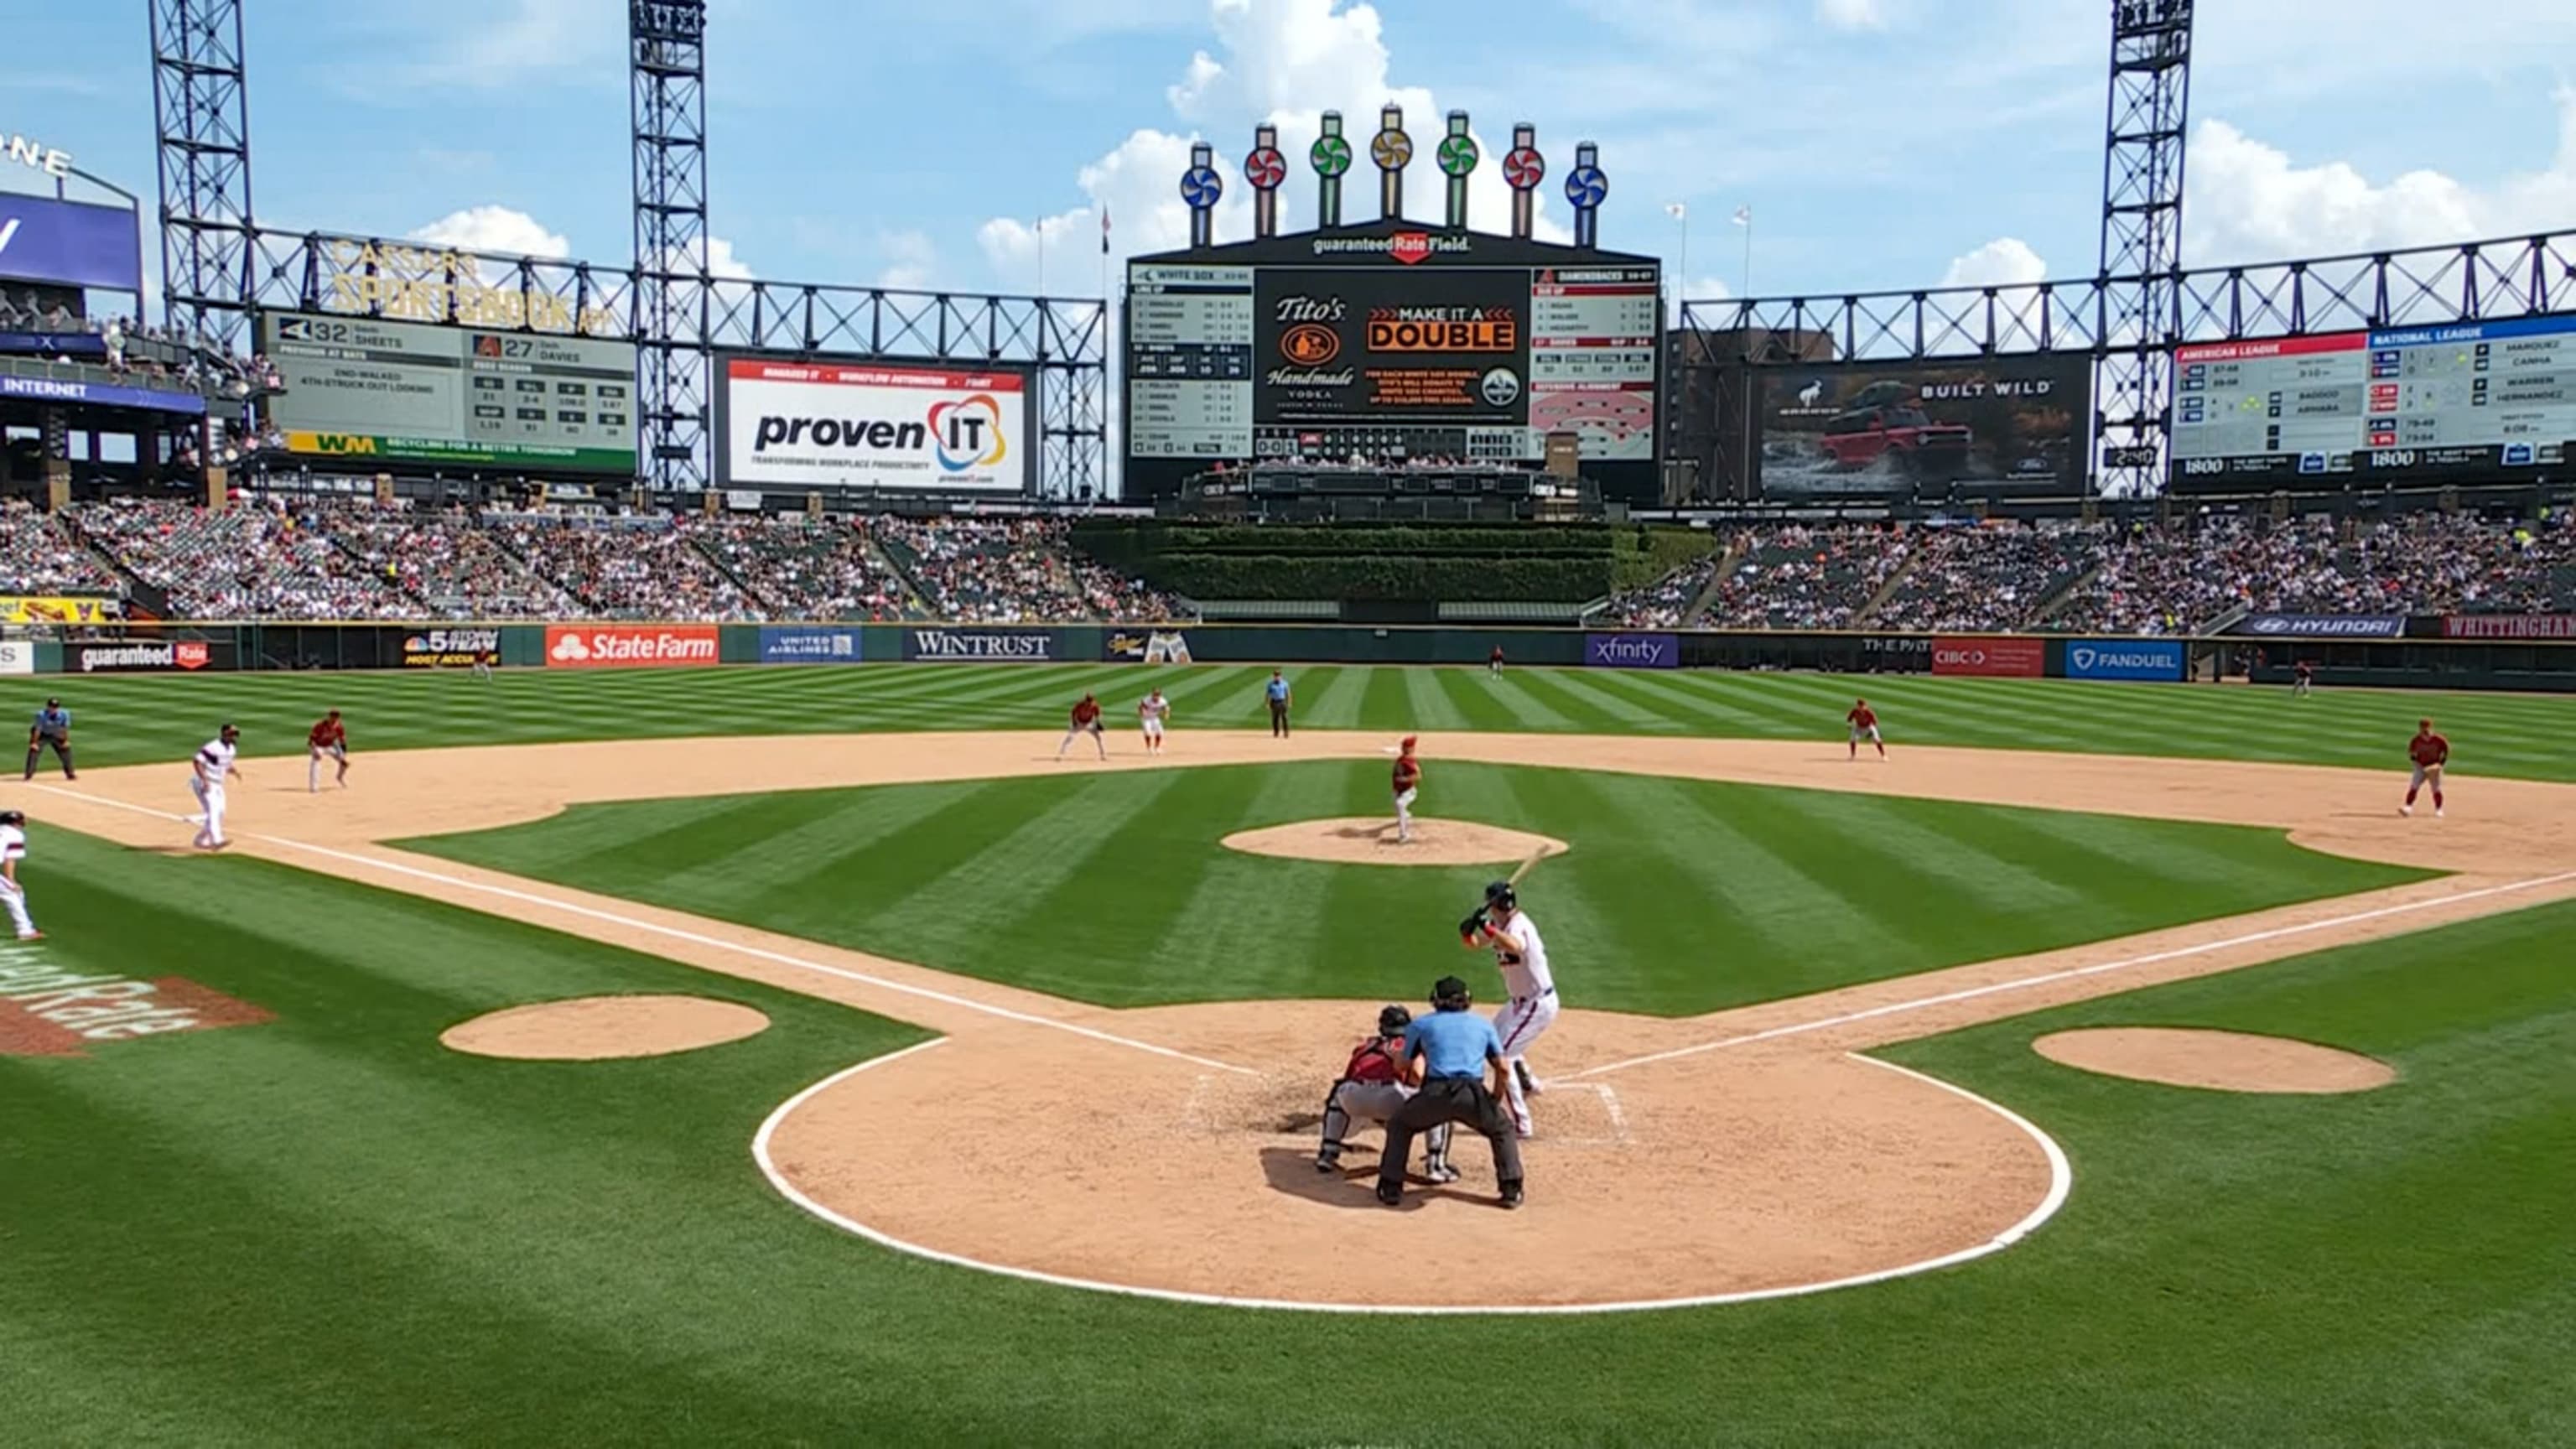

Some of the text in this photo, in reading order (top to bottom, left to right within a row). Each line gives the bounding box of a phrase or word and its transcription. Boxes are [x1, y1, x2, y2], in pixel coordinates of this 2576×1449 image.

[0, 135, 70, 178] NE
[1313, 236, 1392, 254] guaranteed
[1395, 236, 1427, 252] Rate
[335, 240, 477, 279] CAESARS
[335, 273, 571, 332] SPORTSBOOK
[1276, 297, 1346, 320] Tito's
[1399, 308, 1484, 320] MAKE IT A
[315, 323, 347, 343] 32
[355, 335, 402, 349] SHEETS
[1371, 324, 1512, 348] DOUBLE
[2373, 327, 2482, 345] NATIONAL LEAGUE
[505, 339, 533, 357] 27
[540, 351, 580, 363] DAVIES
[2182, 343, 2280, 360] AMERICAN LEAGUE
[1267, 366, 1354, 386] Handmade
[3, 379, 87, 400] INTERNET
[1288, 390, 1332, 399] VODKA
[1922, 381, 2051, 399] BUILT WILD
[755, 416, 984, 451] proven IT
[317, 434, 377, 454] WM
[387, 437, 444, 451] RECYCLING
[447, 441, 467, 450] FOR
[470, 442, 480, 451] A
[751, 455, 930, 471] TRANSFORMING WORKPLACE PRODUCTIVITY
[2184, 458, 2223, 475] 1800
[2371, 450, 2415, 467] 1800
[2293, 620, 2392, 634] HYUNDAI
[428, 631, 448, 652] 5
[591, 634, 714, 659] State Farm
[781, 636, 830, 645] UNITED
[916, 631, 1051, 655] WINTRUST
[81, 646, 207, 671] guaranteed Rate
[768, 646, 830, 655] AIRLINES
[1596, 636, 1664, 664] xfinity
[1935, 650, 1970, 664] CIBC
[405, 654, 439, 665] MOST
[2099, 653, 2176, 669] FANDUEL
